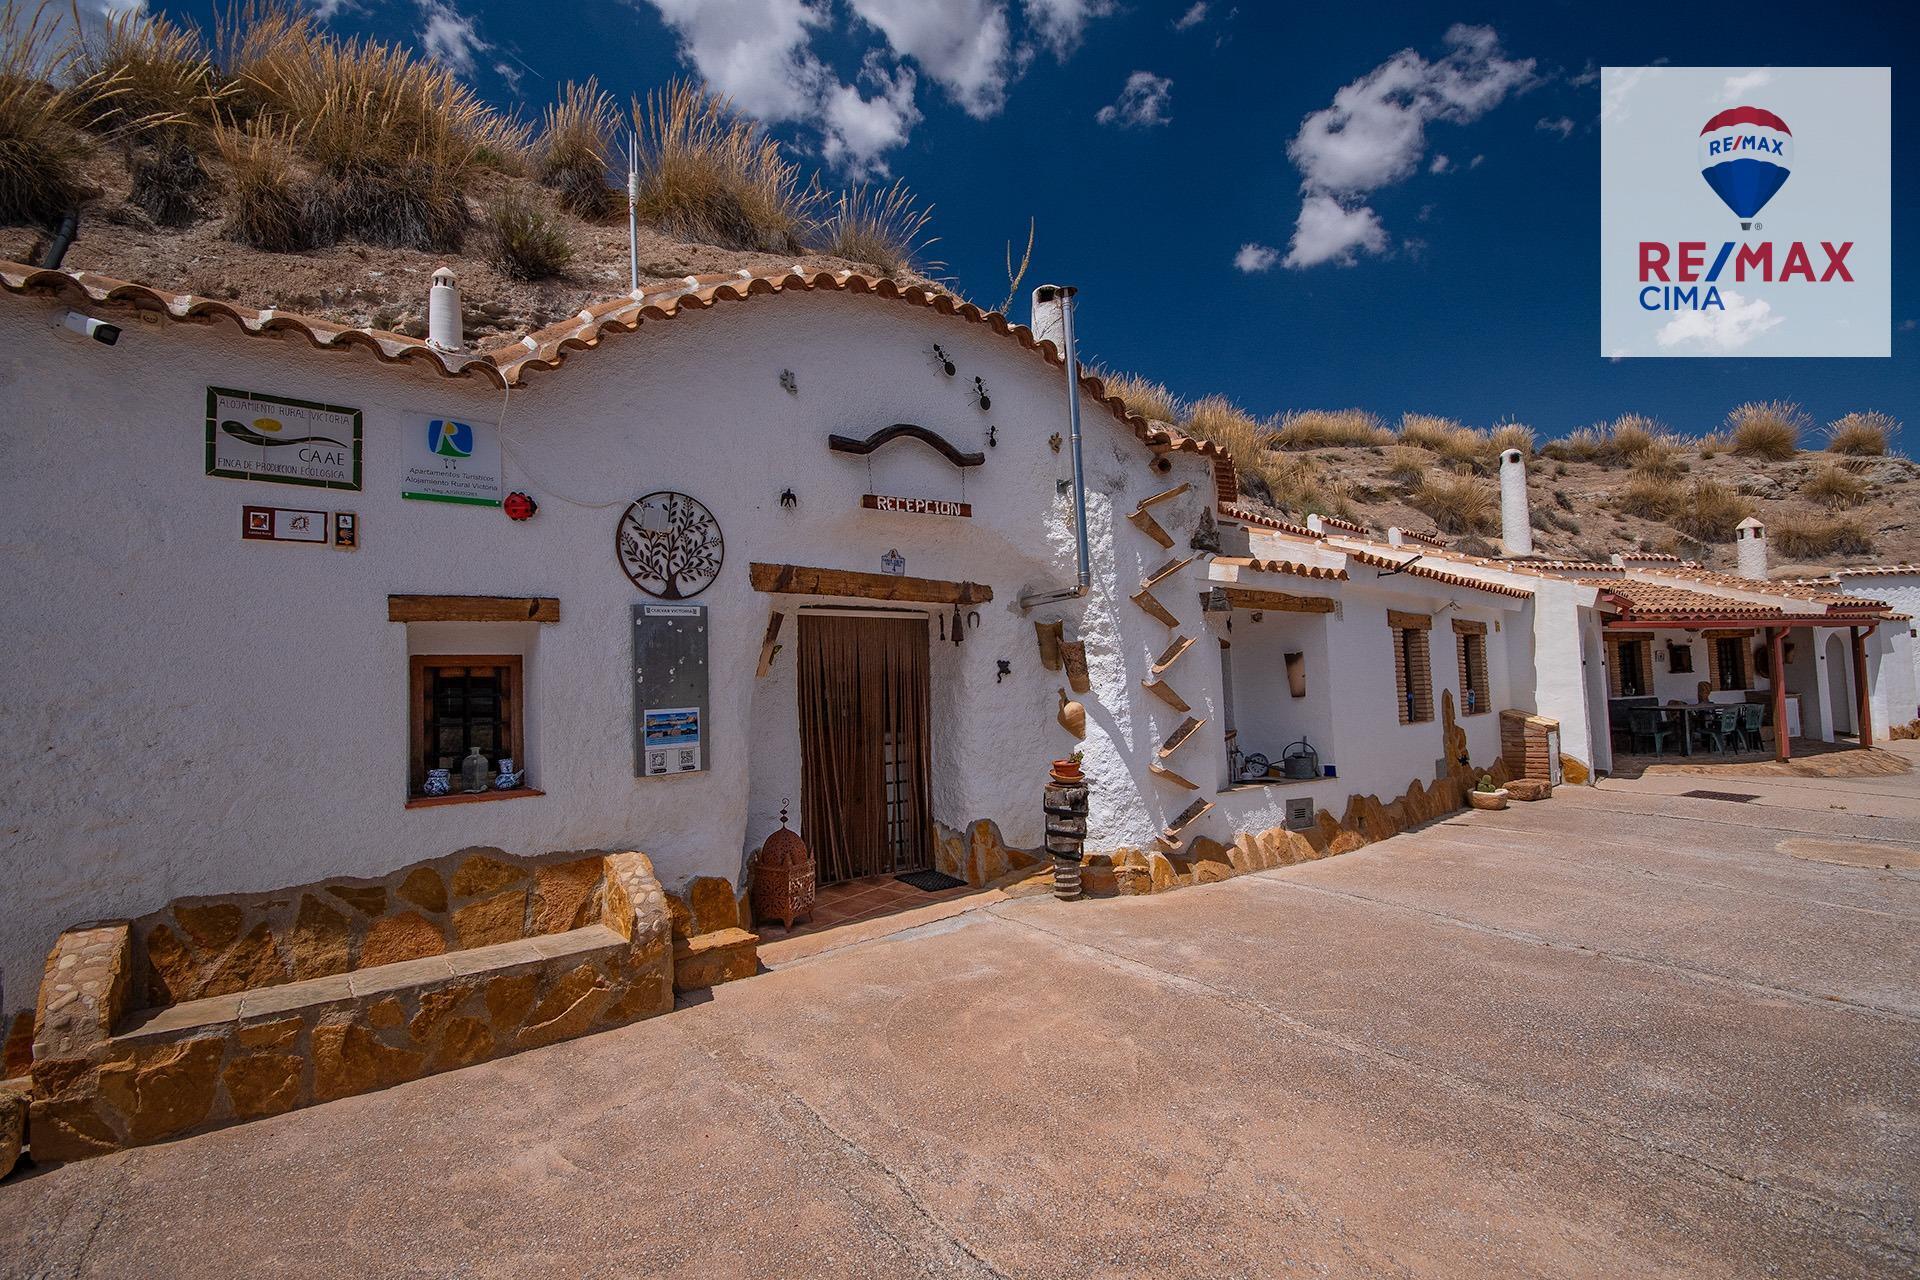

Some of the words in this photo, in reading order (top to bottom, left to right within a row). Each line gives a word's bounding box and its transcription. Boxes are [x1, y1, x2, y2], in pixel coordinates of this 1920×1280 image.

[218, 399, 275, 414] ALOJAMIENTO
[279, 406, 305, 419] RURAL
[311, 413, 350, 425] VICTORIA
[217, 458, 241, 468] FINCA
[243, 460, 252, 470] DE
[299, 448, 345, 466] CAAE
[409, 467, 460, 479] Apartamentos
[405, 476, 449, 487] Alojamiento
[450, 481, 470, 489] Rural
[472, 482, 498, 491] Victoria
[877, 496, 961, 516] RECEPCION
